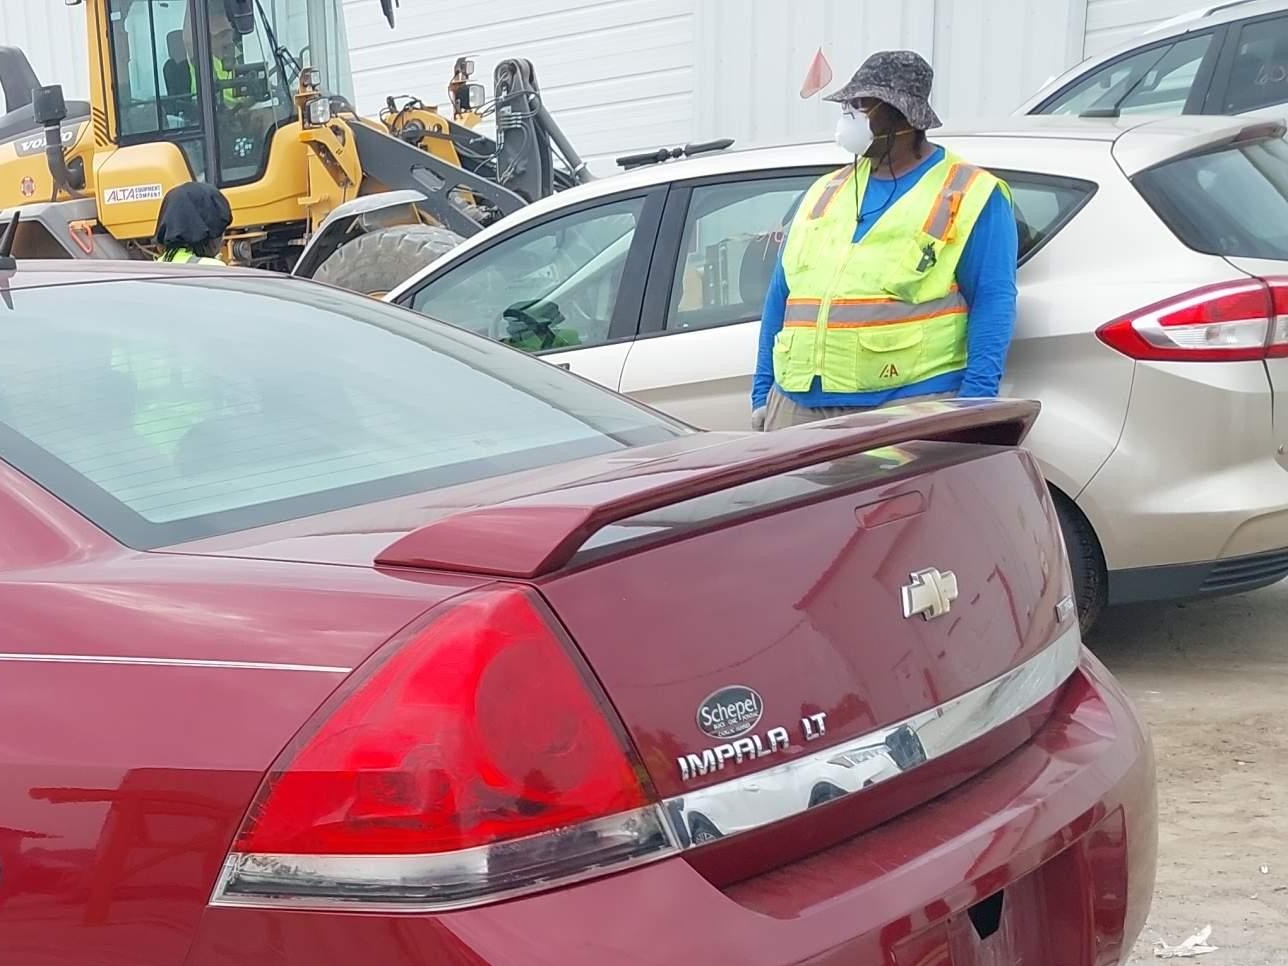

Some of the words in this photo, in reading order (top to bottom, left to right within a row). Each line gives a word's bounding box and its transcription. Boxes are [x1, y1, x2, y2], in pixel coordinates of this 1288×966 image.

[107, 188, 135, 202] ALTA
[701, 692, 758, 727] Schepel
[677, 726, 790, 781] IMPALA
[801, 712, 827, 741] LT
